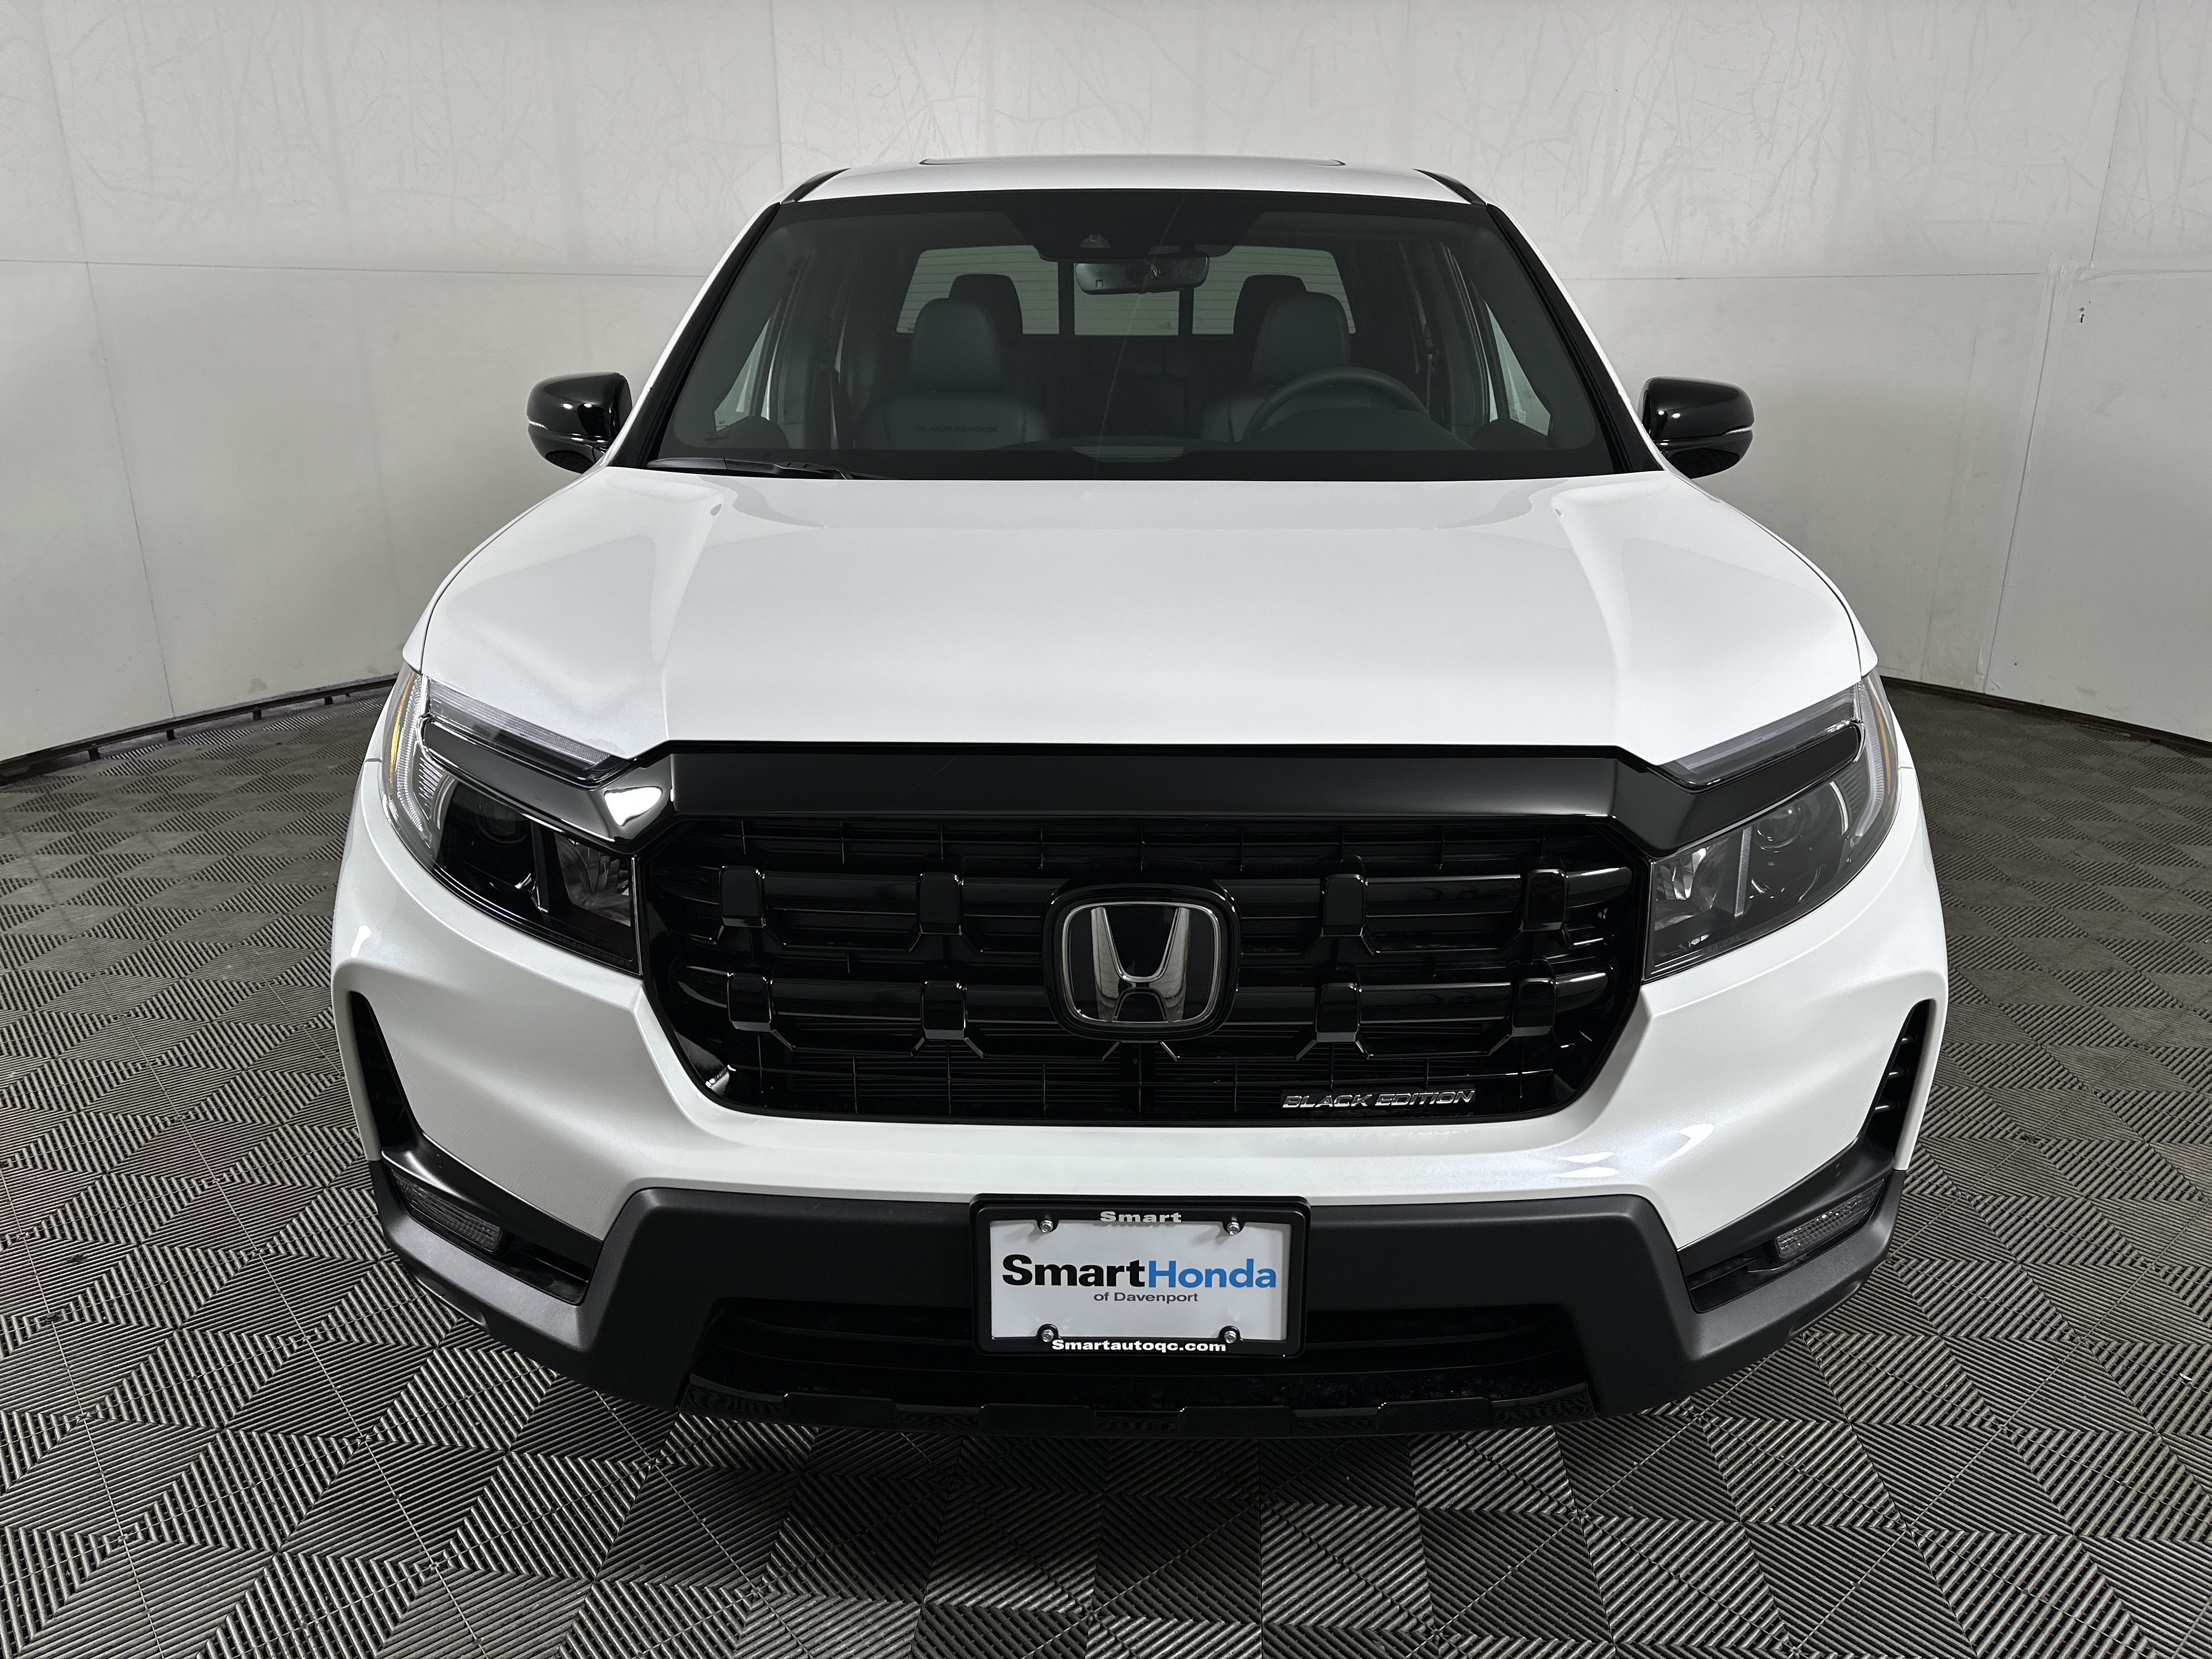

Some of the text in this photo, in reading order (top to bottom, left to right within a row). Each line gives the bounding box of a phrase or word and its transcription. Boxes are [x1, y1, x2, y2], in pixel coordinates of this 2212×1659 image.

[1282, 1090, 1475, 1108] BLACK EDITION
[1101, 1211, 1182, 1223] Smart
[1093, 1292, 1198, 1304] of Davenport
[1052, 1340, 1226, 1353] Smartautoqc.com
